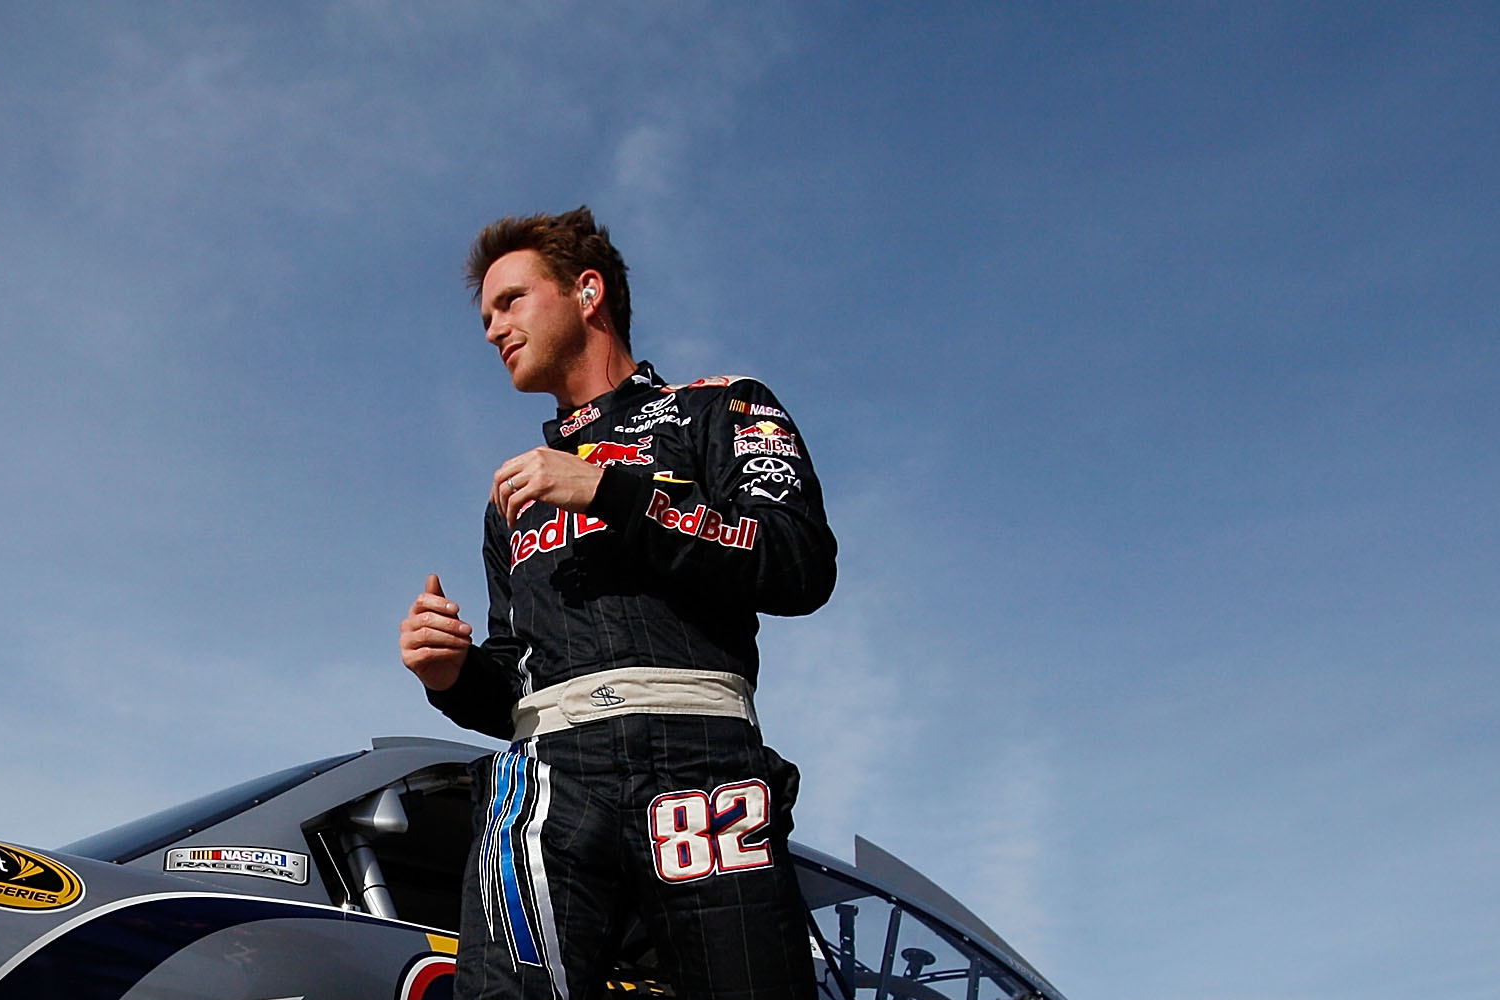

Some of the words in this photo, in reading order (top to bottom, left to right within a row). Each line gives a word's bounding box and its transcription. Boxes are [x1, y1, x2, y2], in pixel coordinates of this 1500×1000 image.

[631, 405, 680, 423] TOYOTA
[749, 404, 790, 421] NASCA
[559, 417, 581, 438] Red
[578, 407, 602, 428] Bull
[734, 439, 770, 457] Red
[646, 488, 706, 536] Red
[699, 508, 758, 550] Bull
[647, 778, 773, 884] 82
[220, 849, 282, 866] NASCAR
[174, 861, 242, 871] RACE
[245, 864, 298, 880] CAR
